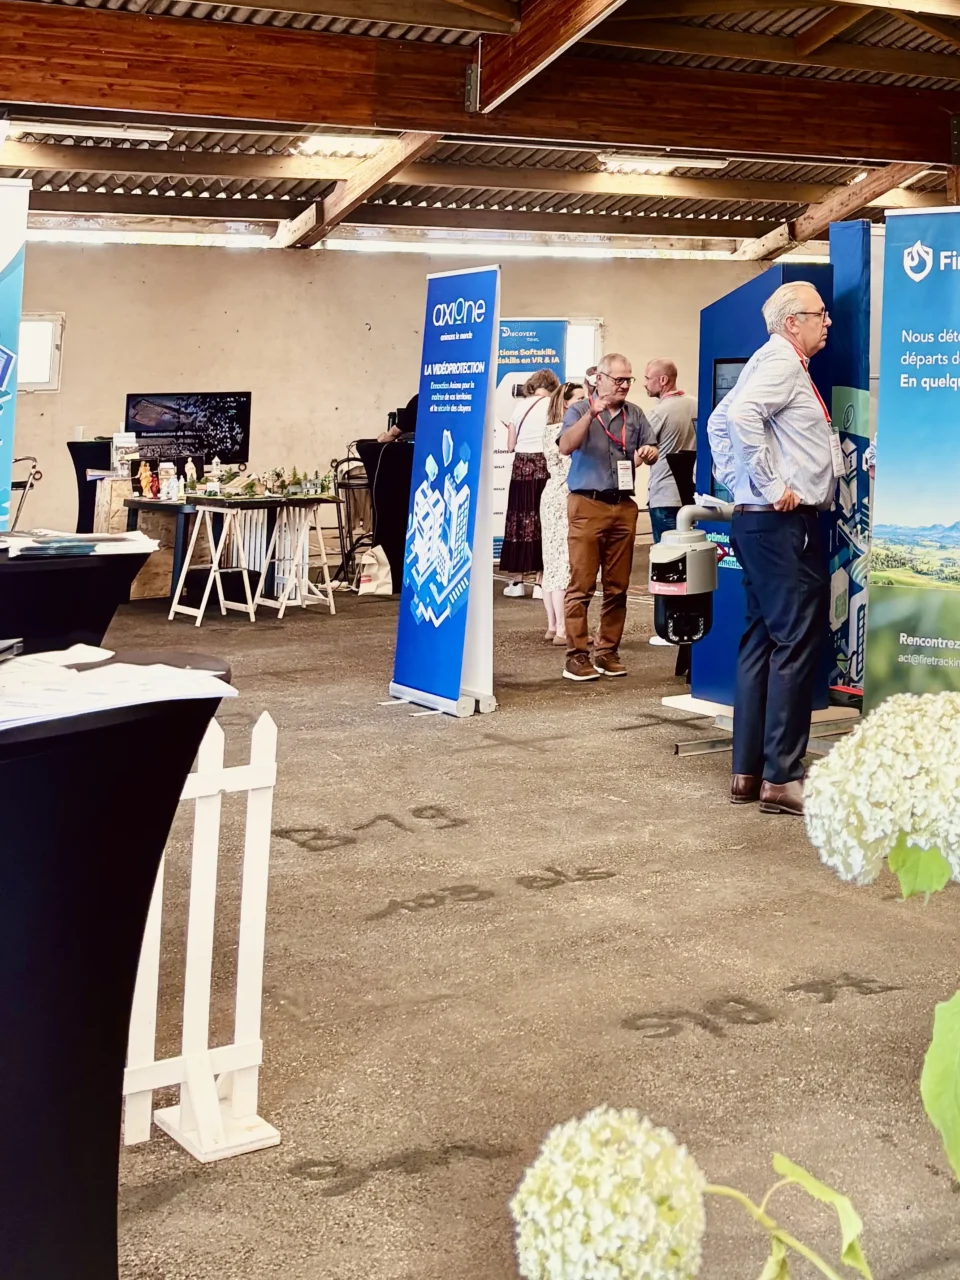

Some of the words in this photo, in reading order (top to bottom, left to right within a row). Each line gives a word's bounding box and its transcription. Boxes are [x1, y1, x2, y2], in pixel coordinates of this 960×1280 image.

[901, 329, 934, 343] Nous
[900, 351, 948, 370] départs
[900, 373, 917, 388] En
[899, 632, 960, 649] Rencontrez
